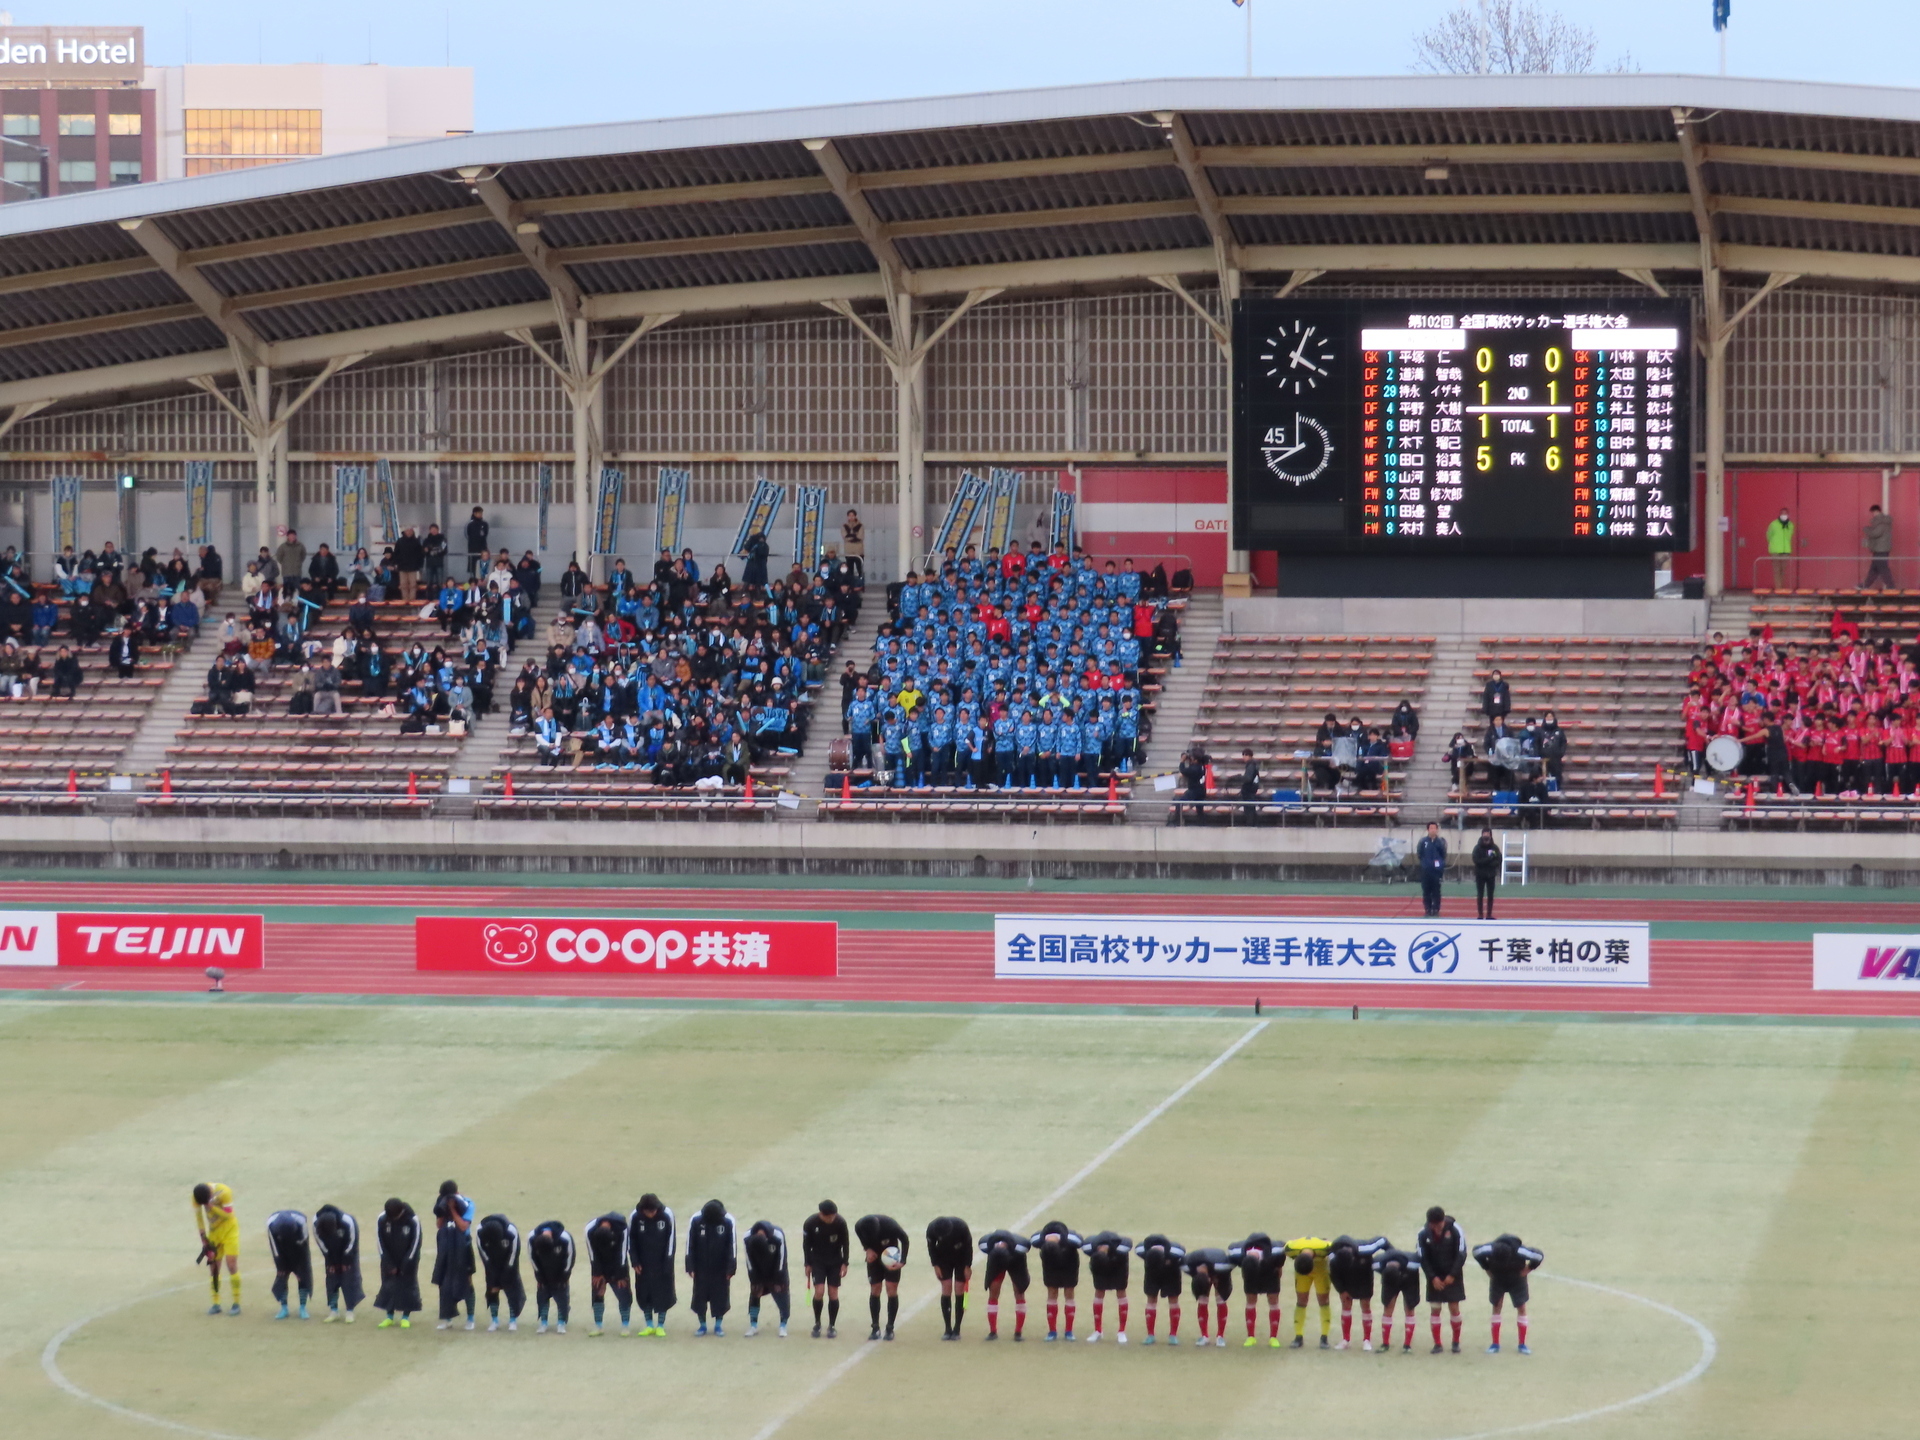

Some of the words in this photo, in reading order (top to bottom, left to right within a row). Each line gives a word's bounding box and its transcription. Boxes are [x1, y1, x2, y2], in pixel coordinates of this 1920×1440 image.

[58, 37, 135, 64] Hotel
[1408, 314, 1453, 329] 第102回
[1459, 314, 1629, 329] 全国高校サッカー選手権大会
[1365, 351, 1380, 363] GK
[1388, 351, 1393, 363] 1
[1399, 351, 1425, 363] 平塚
[1438, 351, 1450, 363] 仁
[1477, 348, 1491, 373] 0
[1508, 354, 1528, 367] 1ST
[1545, 348, 1560, 373] 0
[1575, 351, 1590, 363] GK
[1598, 351, 1604, 362] 1
[1610, 351, 1634, 363] 小林
[1647, 351, 1673, 363] 航大
[1365, 368, 1378, 380] DF
[1387, 368, 1393, 380] 2
[1399, 367, 1424, 381] 道満
[1575, 367, 1588, 380] DF
[1597, 368, 1604, 380] 2
[1610, 367, 1635, 380] 太田
[1365, 385, 1378, 397] DF
[1384, 385, 1397, 397] 29
[1399, 384, 1420, 398] 持永
[1478, 381, 1487, 405] 1
[1508, 387, 1528, 400] 2ND
[1547, 381, 1556, 405] 1
[1575, 385, 1588, 397] DF
[1597, 385, 1604, 397] 4
[1610, 384, 1634, 398] 足立
[1365, 402, 1378, 414] DF
[1387, 402, 1394, 414] 4
[1399, 402, 1424, 415] 平野
[1436, 401, 1462, 415] 大樹
[1575, 402, 1588, 414] DF
[1597, 402, 1604, 414] 5
[1610, 402, 1635, 415] 井上
[1365, 419, 1378, 431] MF
[1387, 419, 1393, 431] 6
[1400, 419, 1420, 432] 田村
[1478, 413, 1487, 438] 1
[1501, 419, 1534, 433] TOTAL
[1547, 413, 1556, 438] 1
[1575, 419, 1588, 432] DF
[1595, 419, 1608, 432] 13
[1610, 418, 1635, 432] 月岡
[1264, 427, 1285, 444] 45
[1365, 436, 1378, 448] MF
[1387, 436, 1393, 448] 7
[1399, 436, 1423, 449] 木下
[1575, 436, 1588, 449] MF
[1597, 437, 1604, 449] 6
[1610, 436, 1635, 449] 田中
[1365, 453, 1378, 466] MF
[1385, 454, 1396, 466] 10
[1400, 454, 1424, 466] 田口
[1477, 446, 1491, 471] 5
[1510, 453, 1525, 465] PK
[1545, 446, 1560, 471] 6
[1575, 454, 1588, 466] MF
[1597, 454, 1604, 466] 8
[1365, 471, 1378, 483] MF
[1385, 471, 1397, 483] 13
[1399, 471, 1424, 484] 山河
[1575, 471, 1588, 483] MF
[1595, 471, 1608, 483] 10
[1610, 470, 1623, 484] 原
[1365, 488, 1379, 500] FW
[1387, 488, 1394, 500] 9
[1399, 488, 1420, 500] 太田
[1431, 487, 1462, 501] 修次郎
[1575, 488, 1589, 500] FW
[1595, 488, 1608, 500] 18
[1648, 488, 1661, 501] 力
[1365, 505, 1379, 516] FW
[1385, 505, 1395, 517] 11
[1438, 505, 1451, 518] 望
[1575, 505, 1589, 517] FW
[1597, 505, 1604, 517] 7
[1610, 505, 1635, 518] 小川
[1365, 522, 1379, 534] FW
[1387, 522, 1393, 534] 8
[1399, 522, 1424, 535] 木村
[1575, 522, 1589, 534] FW
[1597, 523, 1604, 535] 9
[1610, 522, 1635, 535] 仲井
[76, 926, 245, 960] TEIJIN
[1007, 933, 1397, 967] 全国高校サッカー選手権大会
[1478, 937, 1630, 965] 千葉・柏の葉
[1858, 947, 1920, 980] VA
